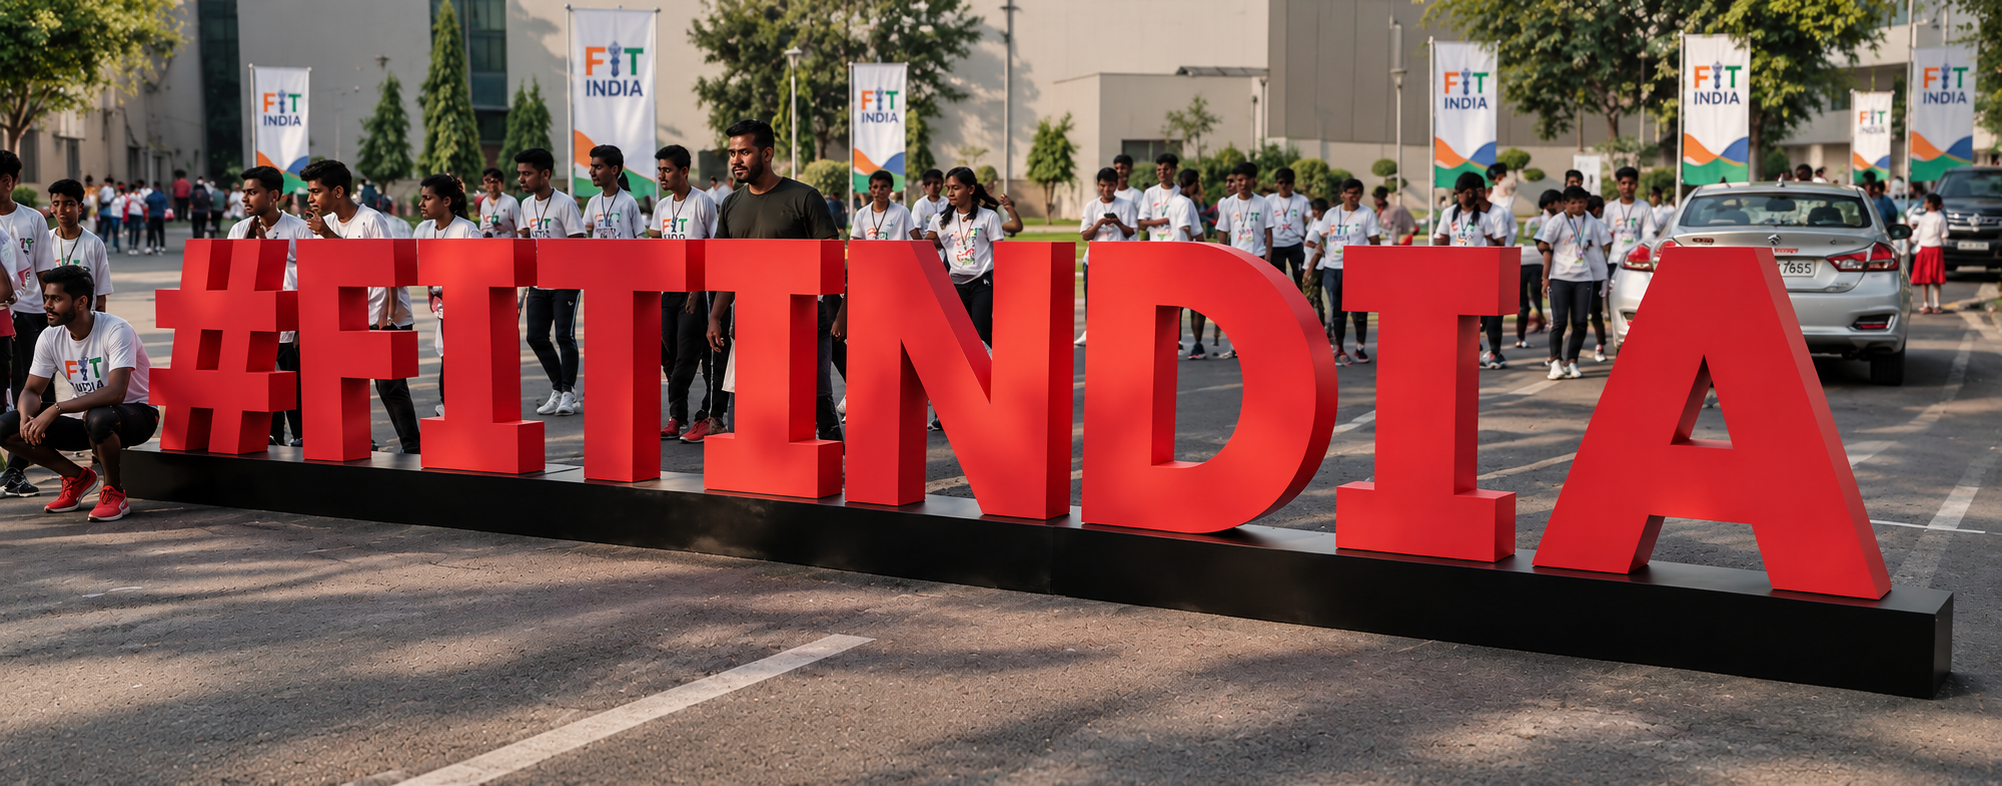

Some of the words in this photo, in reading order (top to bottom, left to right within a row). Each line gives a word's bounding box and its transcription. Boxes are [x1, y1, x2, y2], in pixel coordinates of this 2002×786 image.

[585, 41, 645, 77] FIT
[1444, 68, 1489, 95] FIT
[1694, 61, 1742, 89] FIT
[1923, 63, 1969, 89] FIT
[586, 79, 644, 96] INDIA
[1693, 91, 1740, 105] INDIA
[1922, 91, 1968, 104] INDIA
[263, 89, 302, 114] FIT
[860, 86, 899, 111] FIT
[1444, 97, 1488, 109] INDIA
[263, 114, 302, 126] INDIA
[861, 112, 899, 123] INDIA
[1859, 109, 1886, 125] FIT
[148, 238, 1891, 600] #FITINDIA
